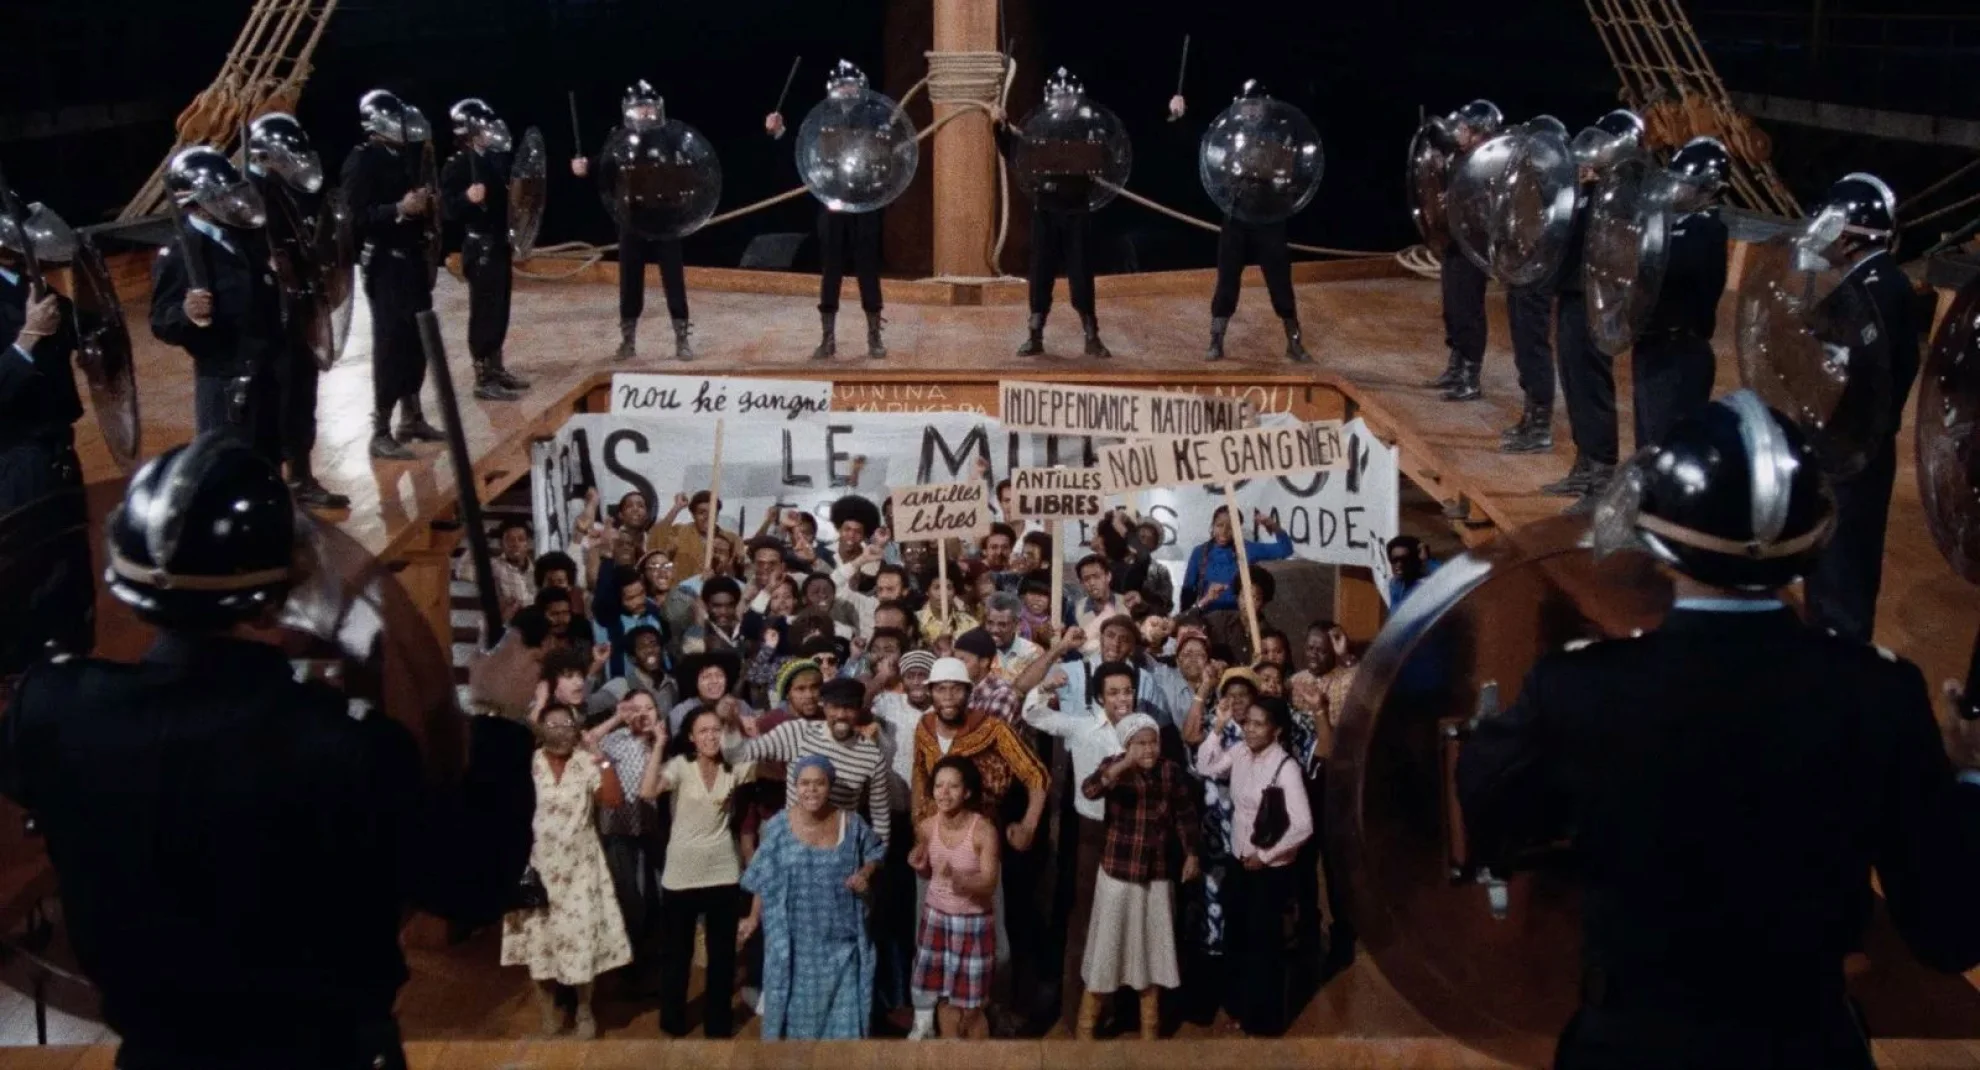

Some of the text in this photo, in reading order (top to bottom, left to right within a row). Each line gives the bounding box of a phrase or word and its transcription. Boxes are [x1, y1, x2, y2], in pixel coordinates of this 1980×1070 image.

[1003, 386, 1140, 433] INDEPENDANCE
[781, 425, 854, 488] LE
[1108, 445, 1159, 489] NOU
[1173, 438, 1213, 482] KE
[900, 484, 981, 507] antilles
[1018, 493, 1101, 516] LIBRES
[906, 504, 978, 534] libres
